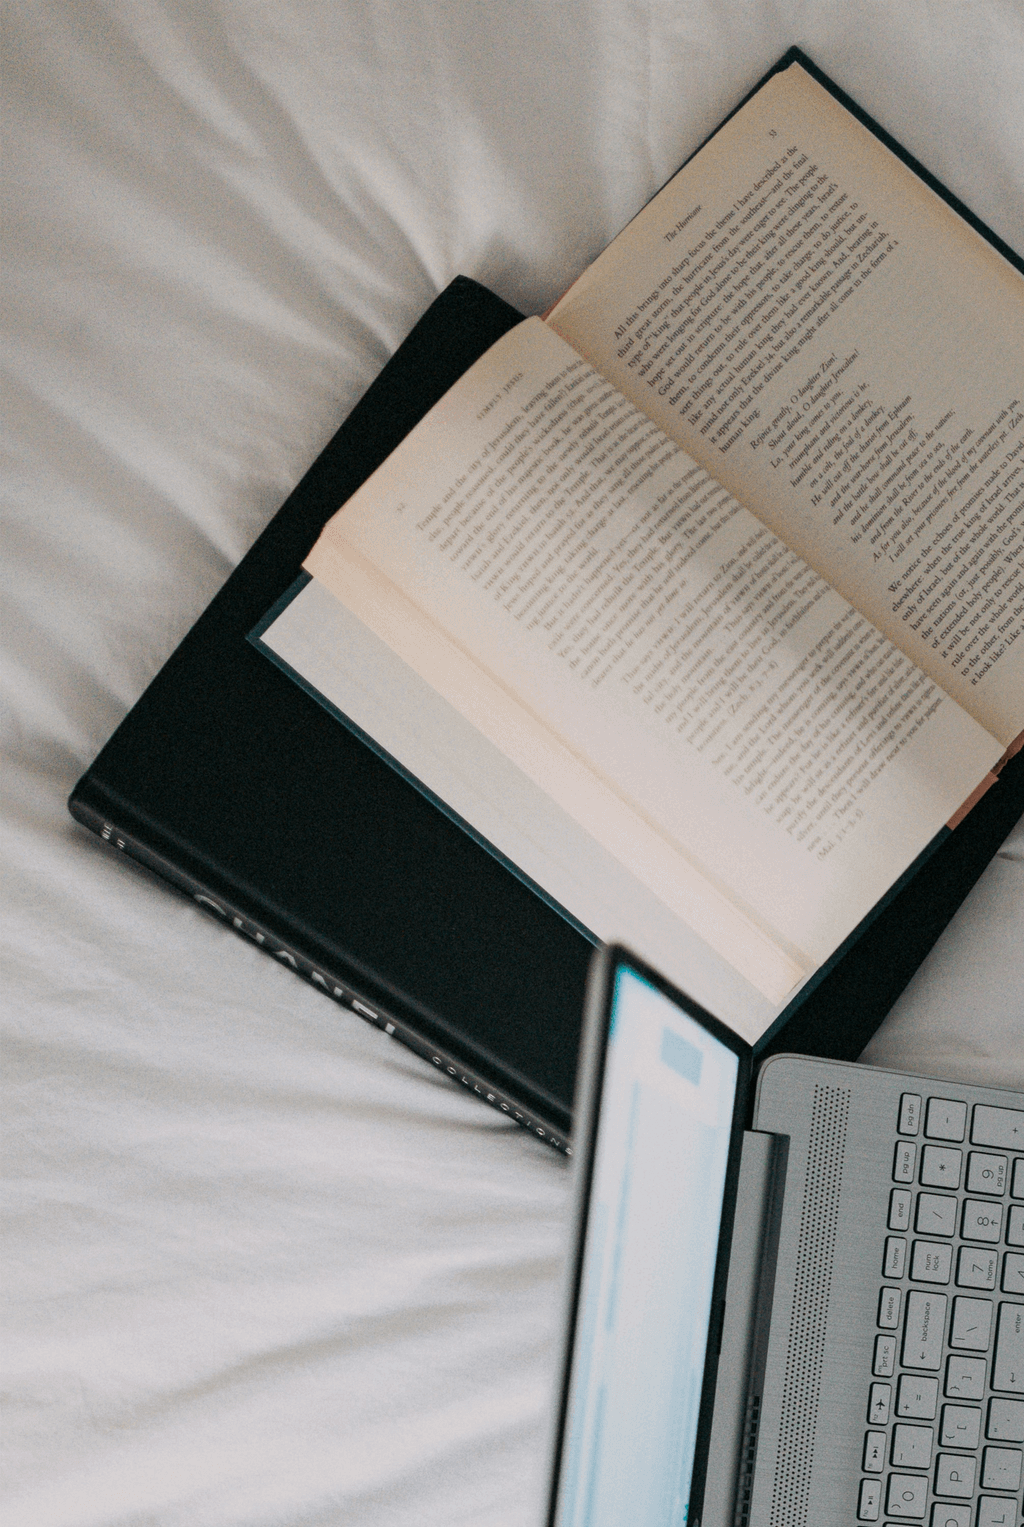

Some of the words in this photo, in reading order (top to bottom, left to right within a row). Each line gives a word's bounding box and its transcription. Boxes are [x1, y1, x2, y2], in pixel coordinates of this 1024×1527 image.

[663, 228, 678, 242] The
[674, 203, 702, 232] Hurricane
[1003, 627, 1021, 646] Like
[987, 642, 1006, 663] like?
[973, 660, 992, 680] look
[969, 676, 978, 686] it
[432, 1056, 573, 1156] COLLECTIONS
[896, 1201, 905, 1218] end
[890, 1246, 900, 1269] home
[931, 1254, 940, 1271] lock
[885, 1296, 894, 1320] delete
[920, 1301, 932, 1341] backspace
[1013, 1313, 1022, 1334] enter
[948, 1469, 963, 1483] P
[990, 1513, 1005, 1524] L
